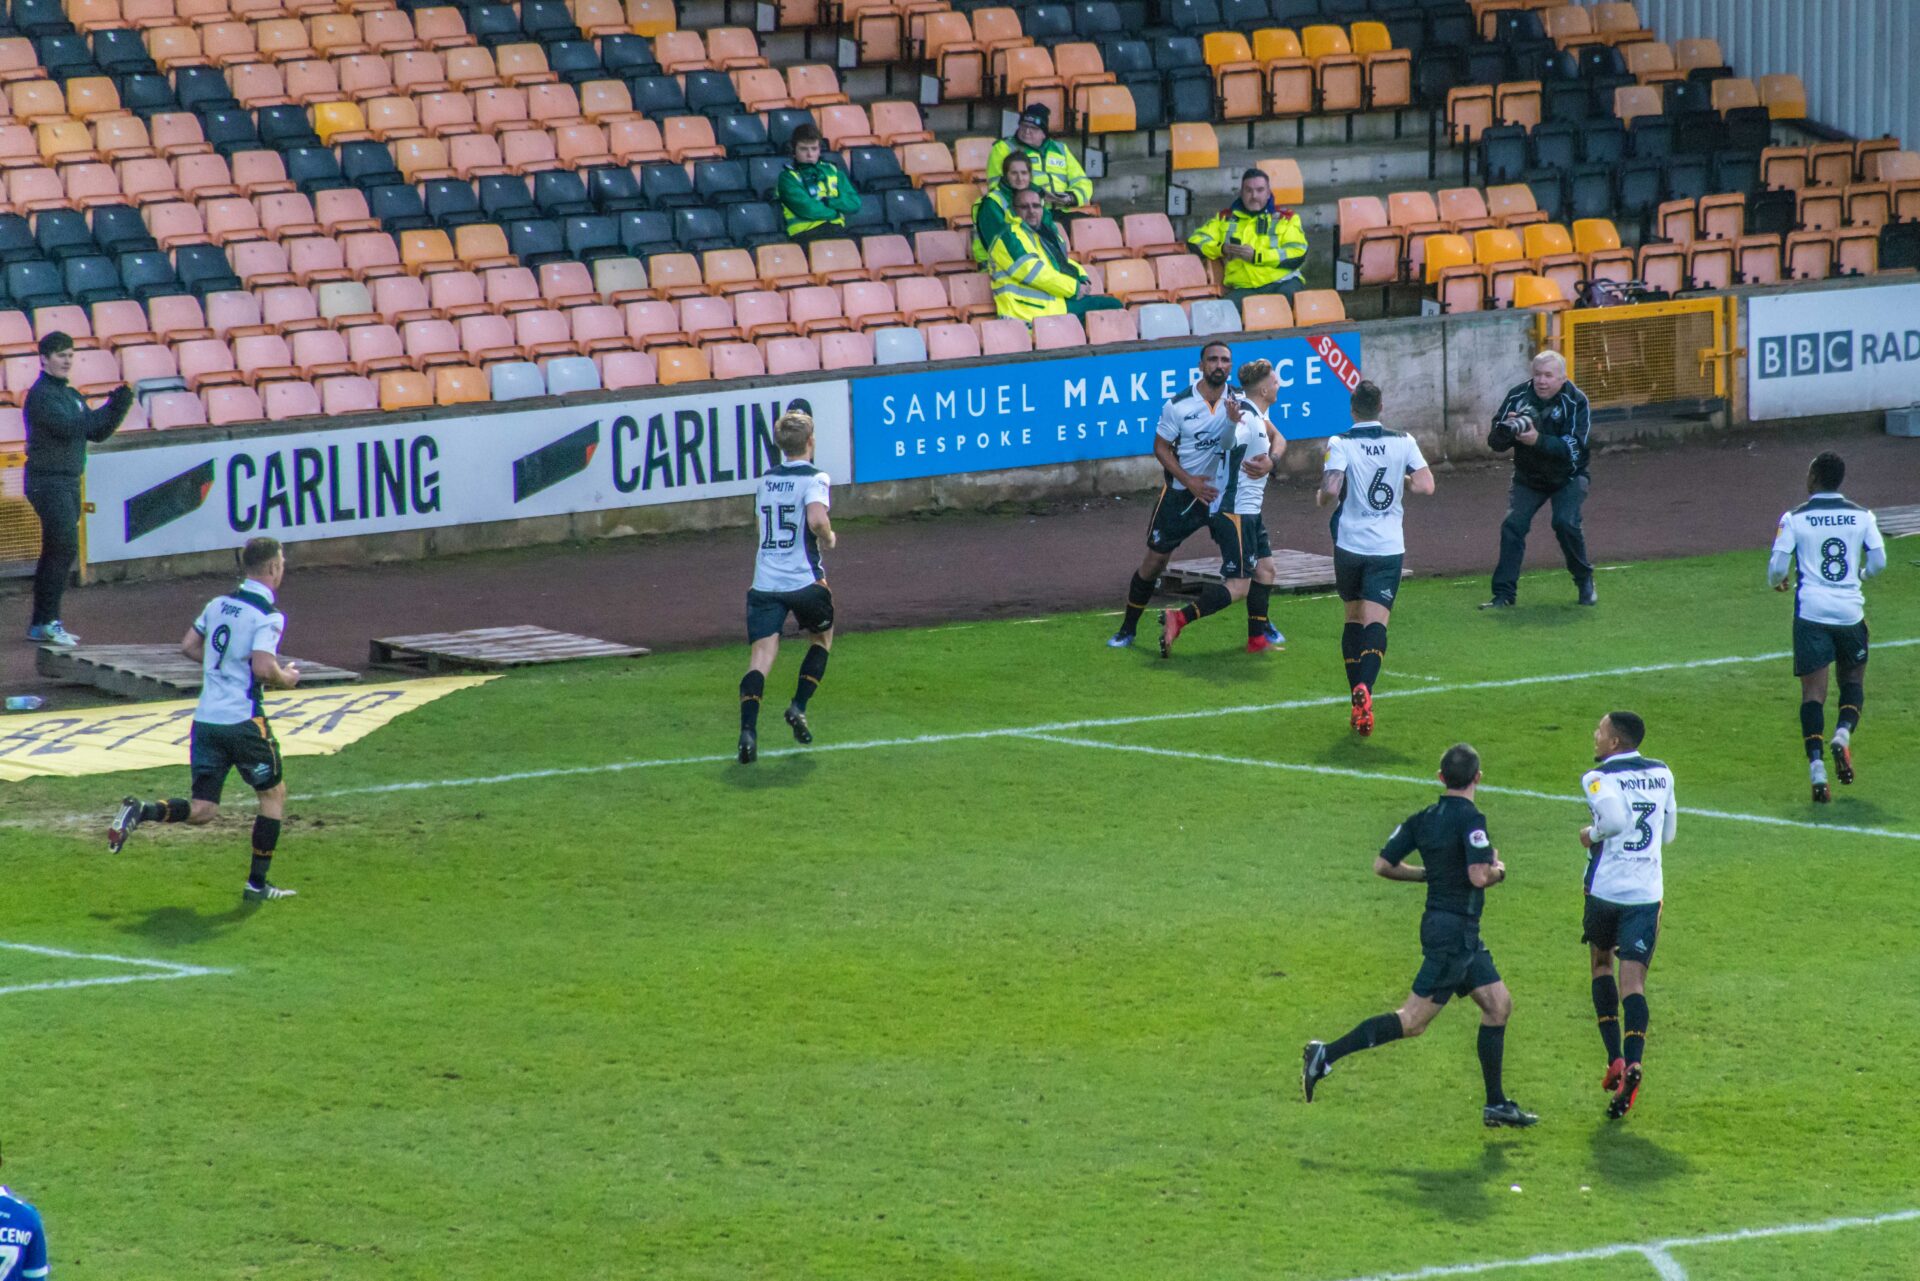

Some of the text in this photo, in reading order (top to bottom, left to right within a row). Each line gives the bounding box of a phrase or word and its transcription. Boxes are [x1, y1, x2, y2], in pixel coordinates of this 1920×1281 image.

[1341, 272, 1348, 282] C
[1317, 336, 1361, 392] SOLD
[1760, 330, 1920, 376] BBC RAD
[882, 383, 1036, 426] SAMUEL
[895, 416, 1160, 457] BESPOKE ESTAT
[1365, 444, 1387, 457] KAY
[226, 434, 442, 533] CARLING
[766, 480, 796, 493] SMITH
[1367, 466, 1395, 511] 6
[760, 504, 798, 550] 15
[1809, 514, 1857, 528] OYELEKE
[1820, 537, 1848, 582] 8
[220, 603, 243, 618] POPE
[211, 623, 231, 670] 9
[1623, 802, 1657, 852] 3
